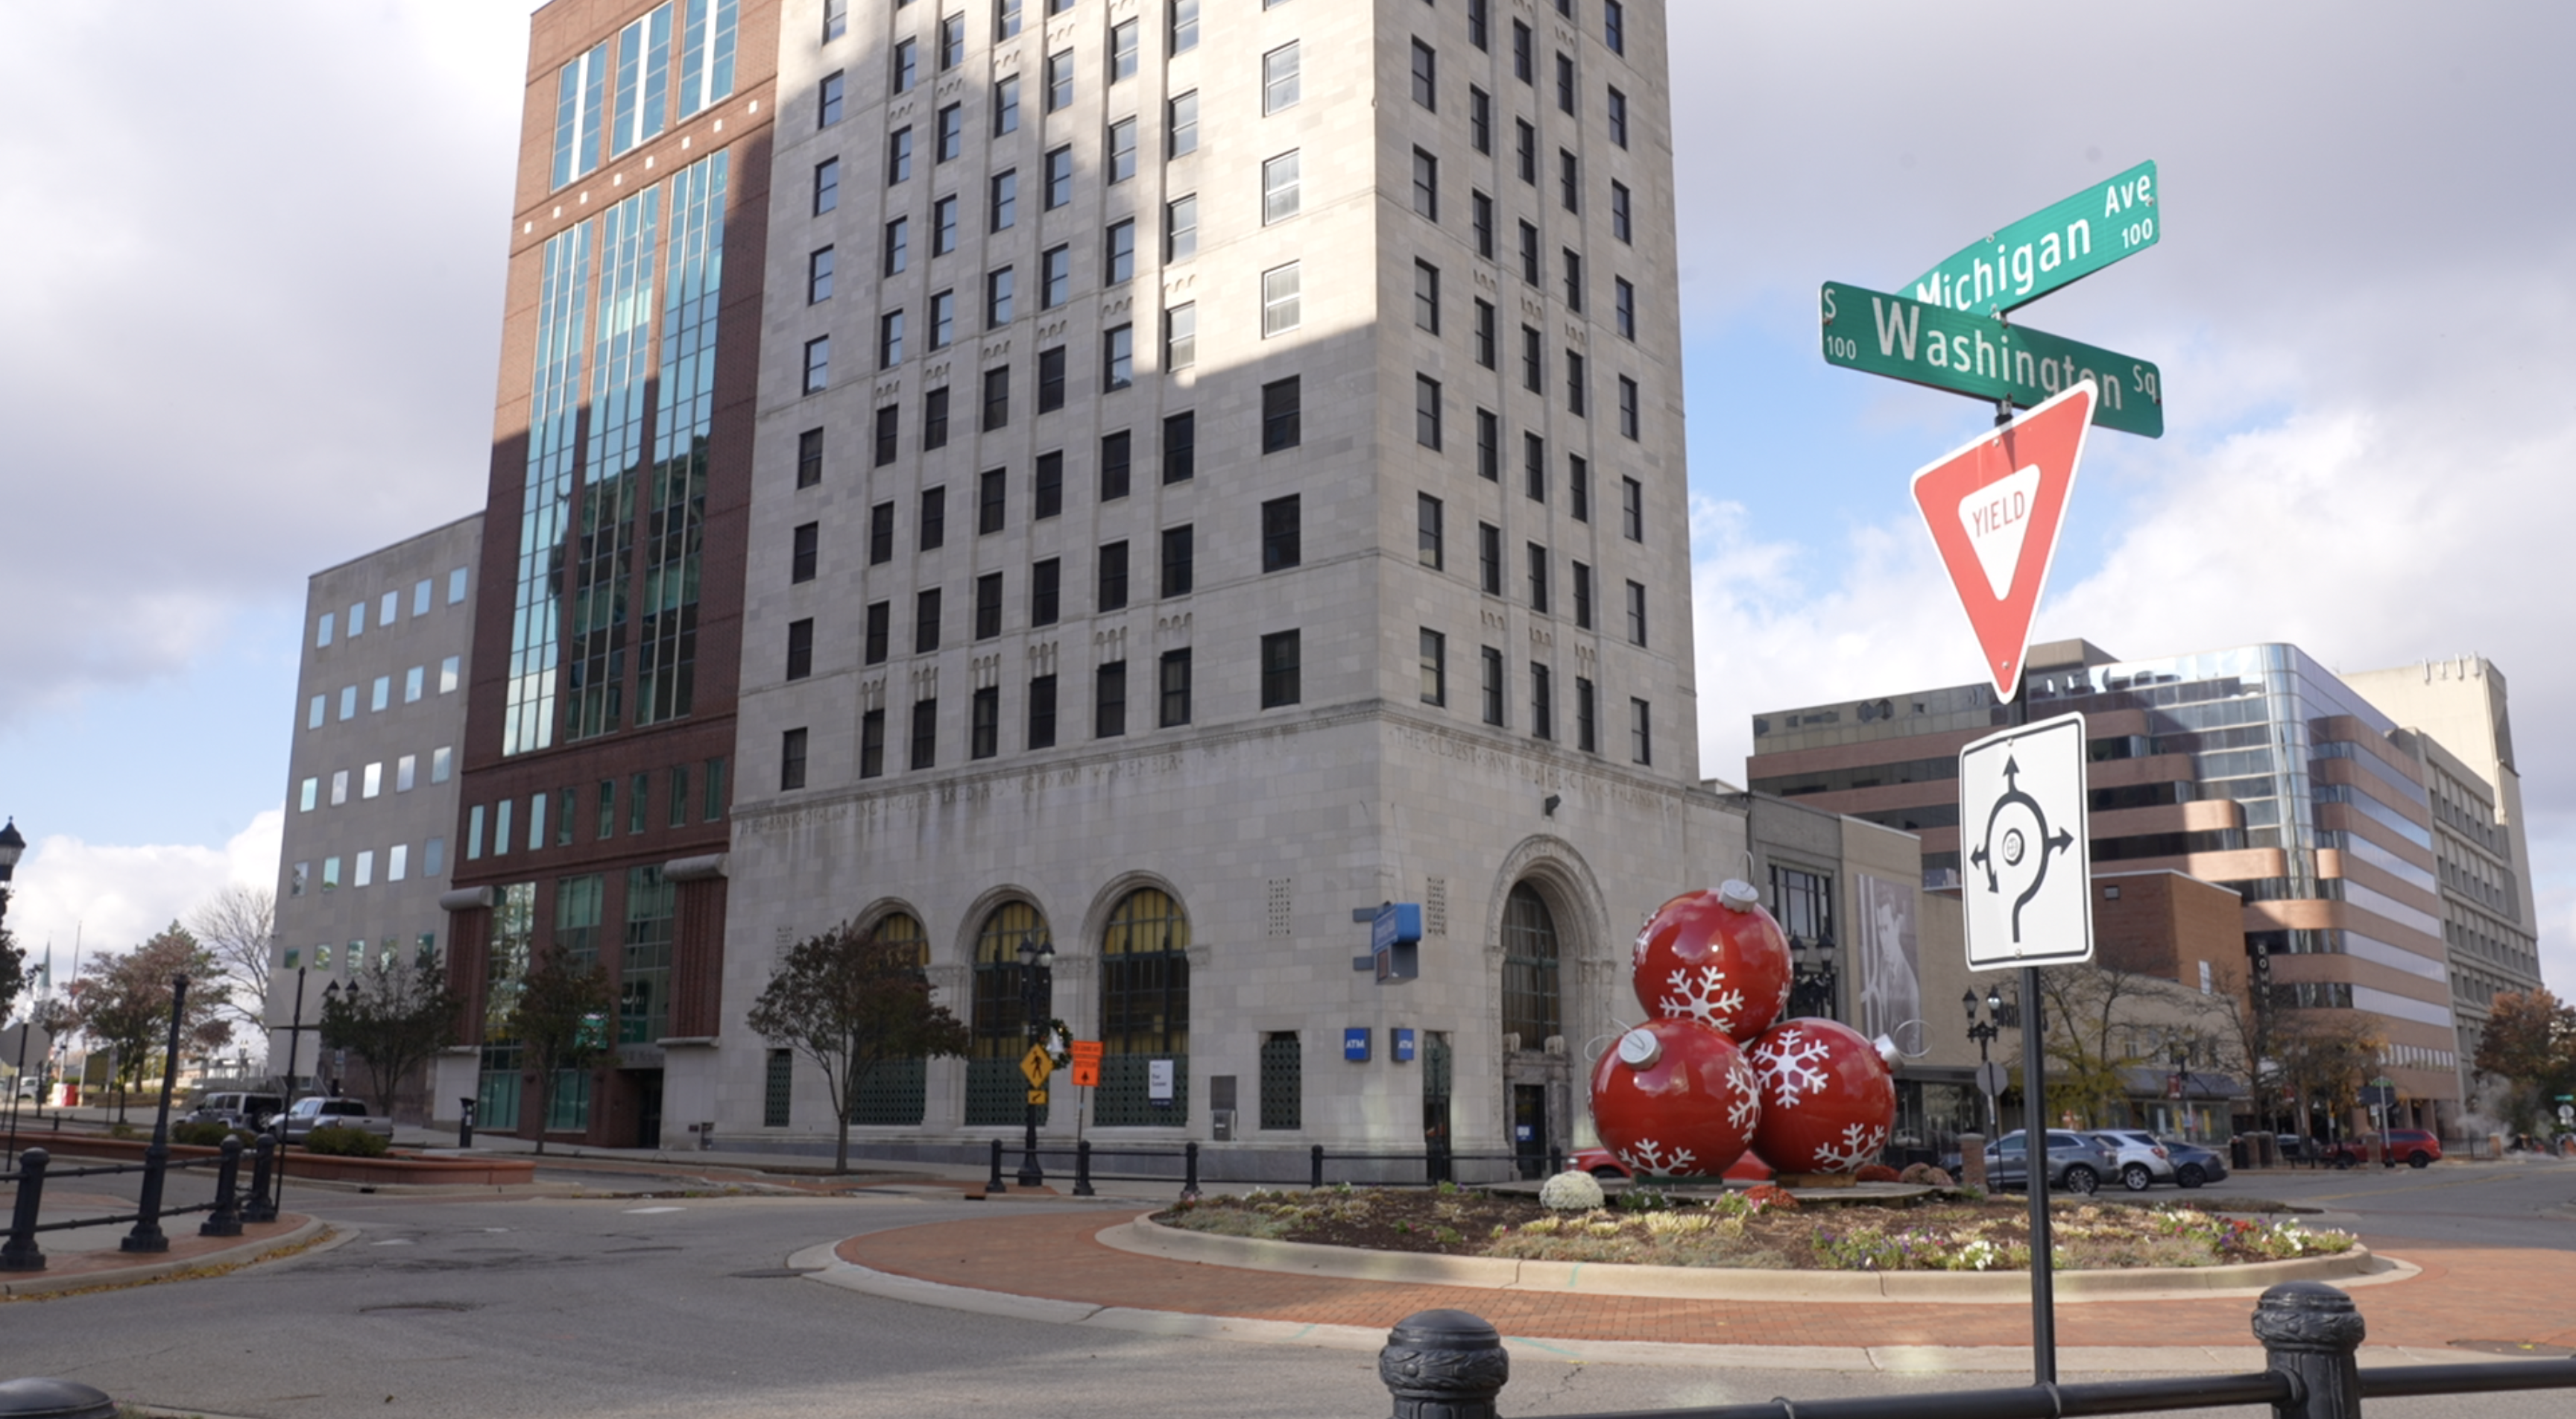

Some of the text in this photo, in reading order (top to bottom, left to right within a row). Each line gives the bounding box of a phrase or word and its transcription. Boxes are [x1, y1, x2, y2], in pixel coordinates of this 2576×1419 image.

[1916, 175, 2150, 312] Michigan Ave
[2121, 218, 2153, 248] 100
[1825, 288, 1837, 319] S
[2133, 364, 2156, 404] Sq
[1827, 335, 1856, 360] 100
[1972, 490, 2025, 537] YIELD
[1428, 735, 1476, 763] OLDEST
[1345, 1039, 1365, 1049] ATM
[1398, 1040, 1412, 1049] ATM
